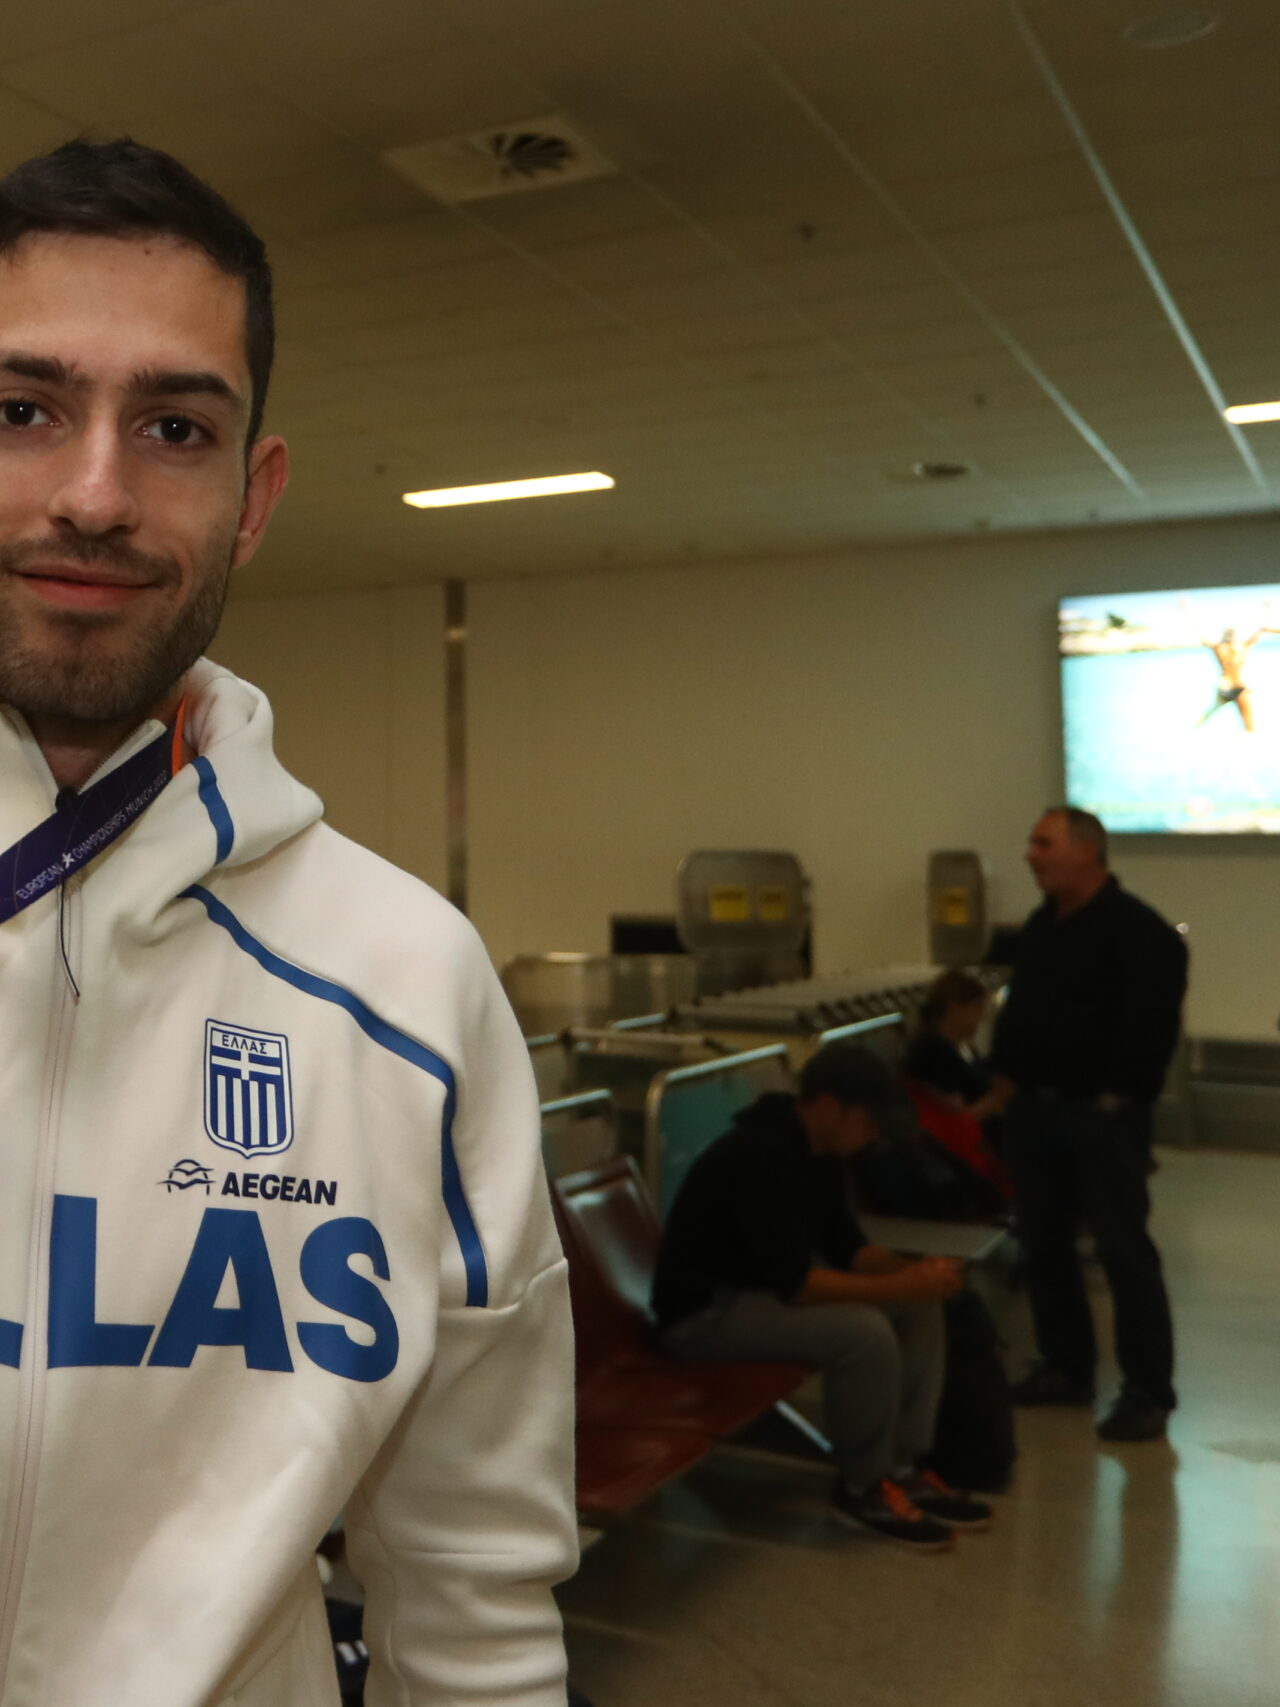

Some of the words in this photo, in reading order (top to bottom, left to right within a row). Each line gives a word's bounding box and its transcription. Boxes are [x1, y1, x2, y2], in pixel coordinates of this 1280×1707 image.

[15, 863, 64, 900] EUROPEAN
[72, 812, 127, 860] CHAMPIONSHIPS
[125, 785, 153, 817] MUNICH
[221, 1034, 268, 1055] ΕΛΛΑΣ
[221, 1171, 338, 1206] AEGEAN
